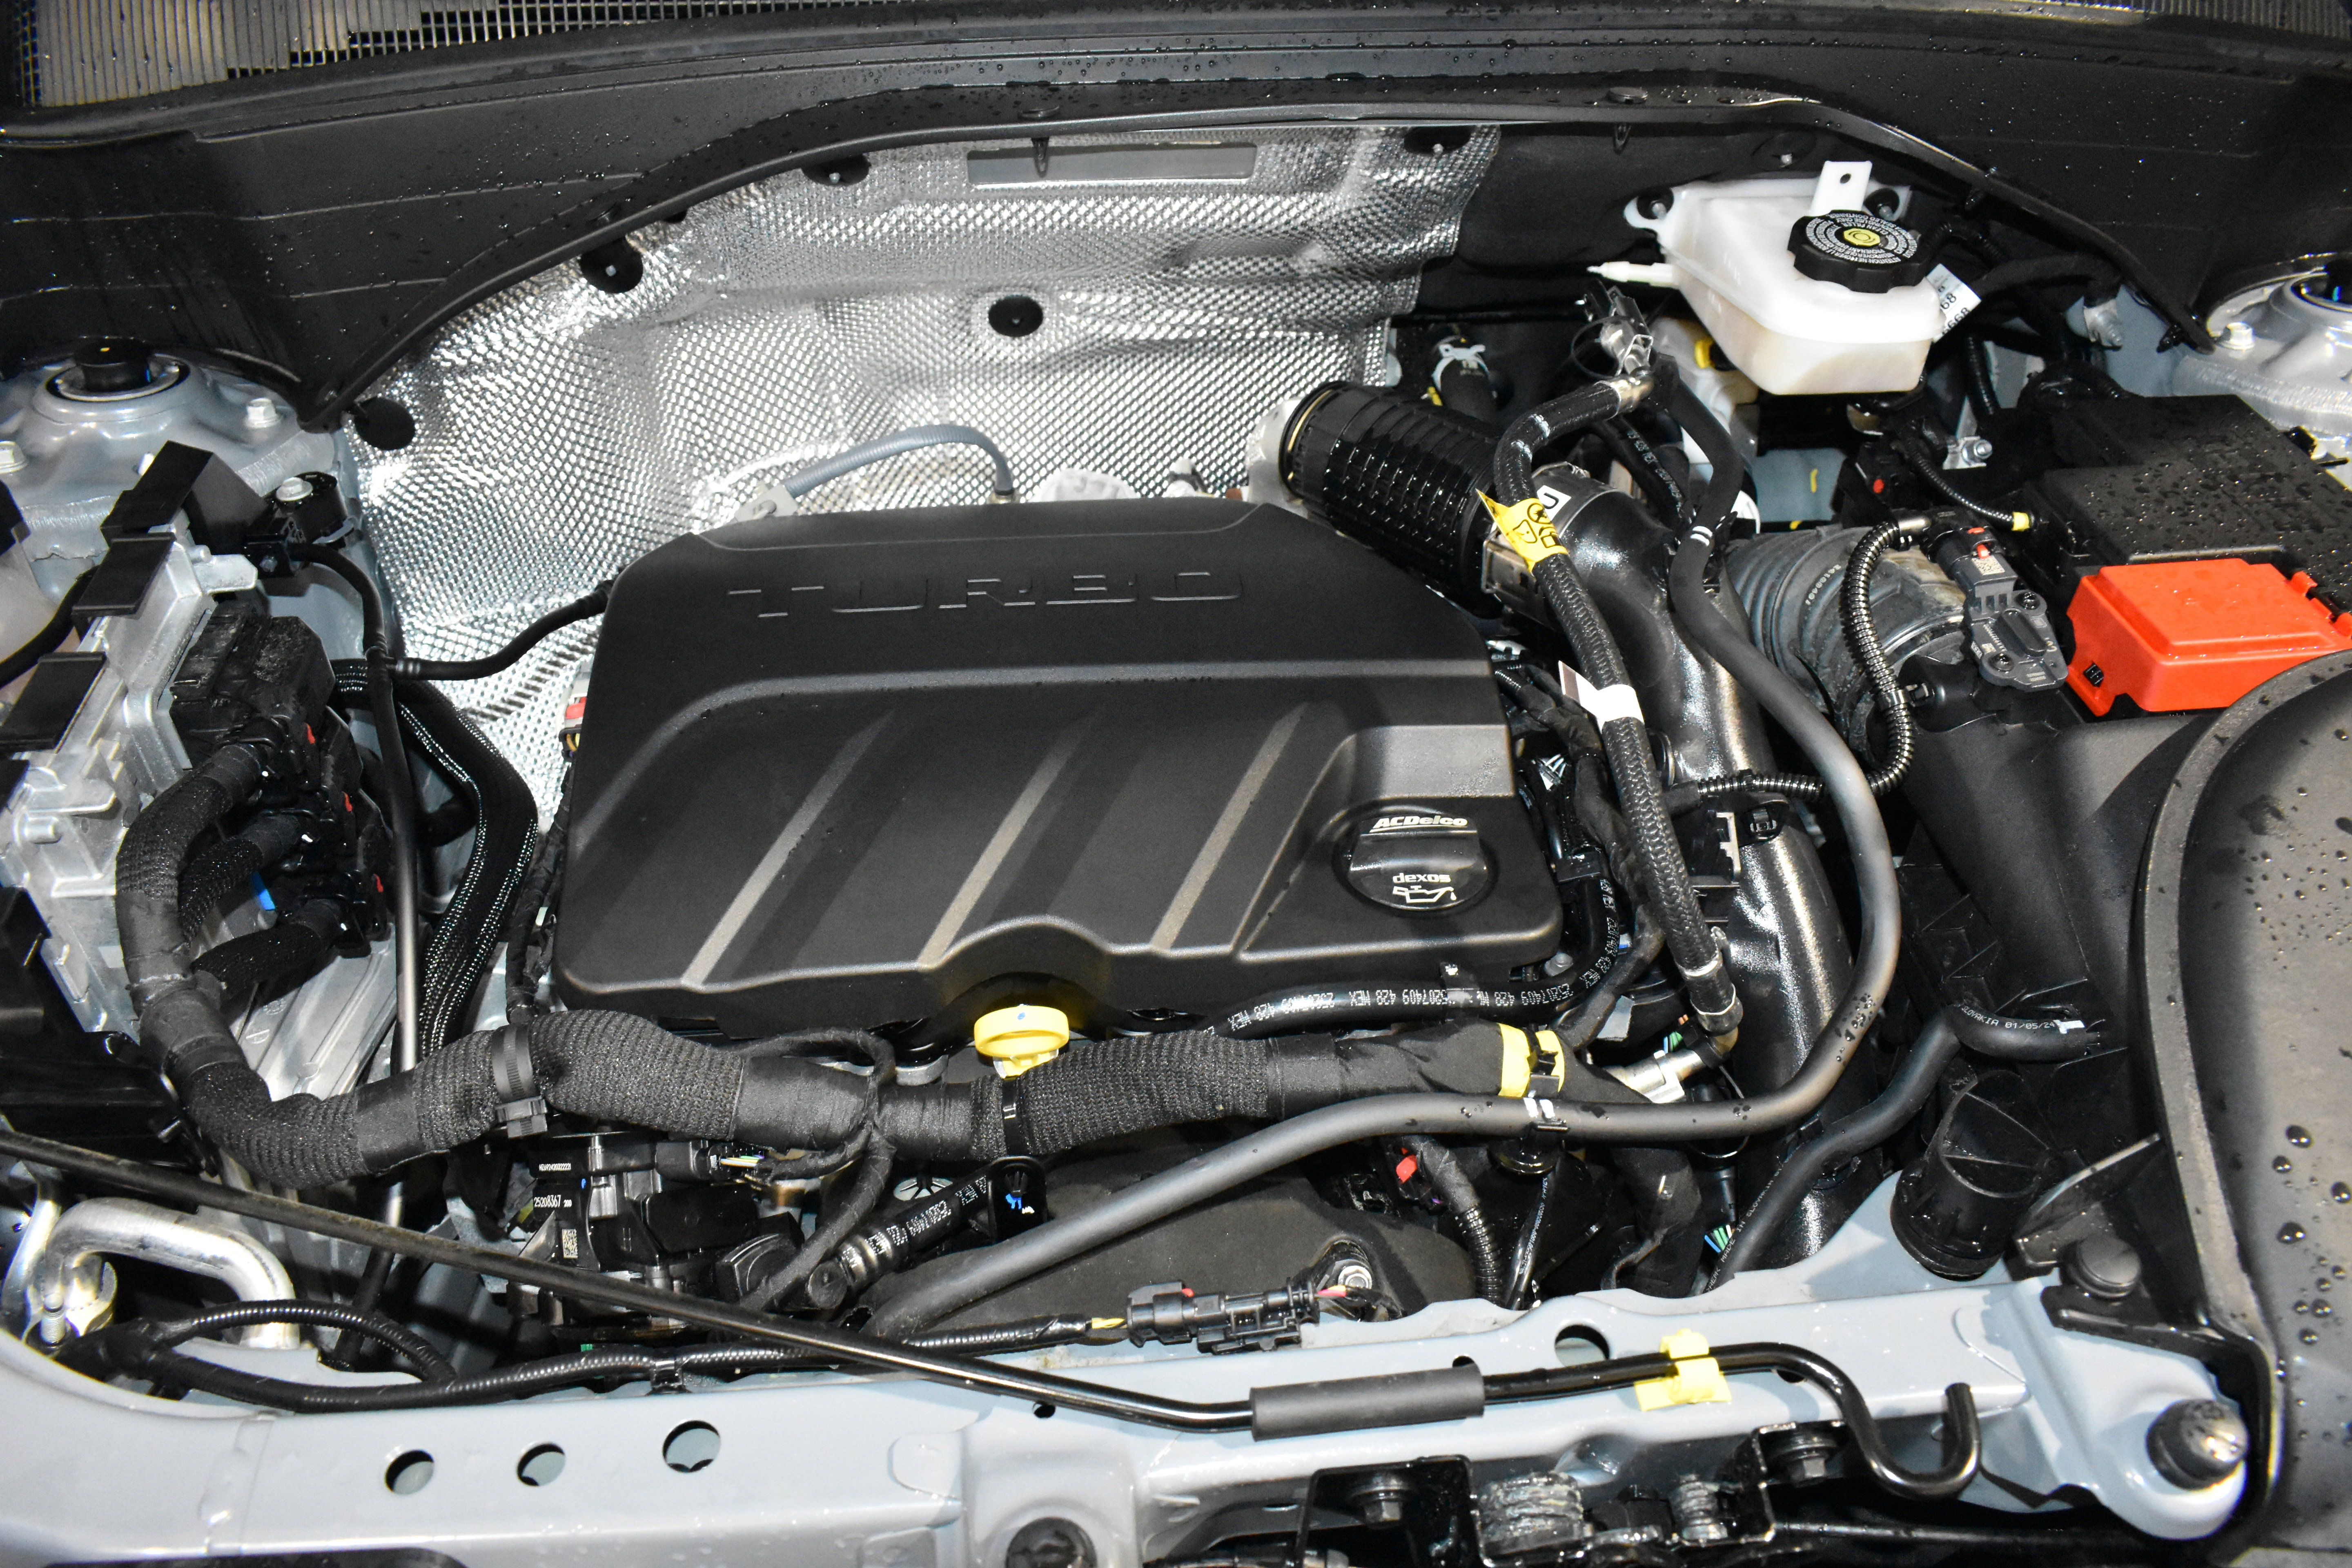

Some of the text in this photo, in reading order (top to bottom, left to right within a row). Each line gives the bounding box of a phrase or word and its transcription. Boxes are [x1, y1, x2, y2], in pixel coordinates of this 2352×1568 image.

[727, 571, 1242, 618] TURBO
[1372, 815, 1468, 829] ACDelco
[1392, 873, 1451, 884] dexos
[1348, 990, 1371, 1006] MEX
[1376, 989, 1396, 1005] 428
[1402, 989, 1452, 1005] 5207409
[1494, 991, 1515, 1007] 428
[1520, 983, 1573, 1005] 25207409
[1226, 1010, 1252, 1031] MEX
[1961, 1006, 1999, 1027] SLOVAKIA
[534, 1194, 572, 1208] 25208367 200
[1721, 1238, 1736, 1263] MADE
[1736, 1221, 1746, 1232] IN
